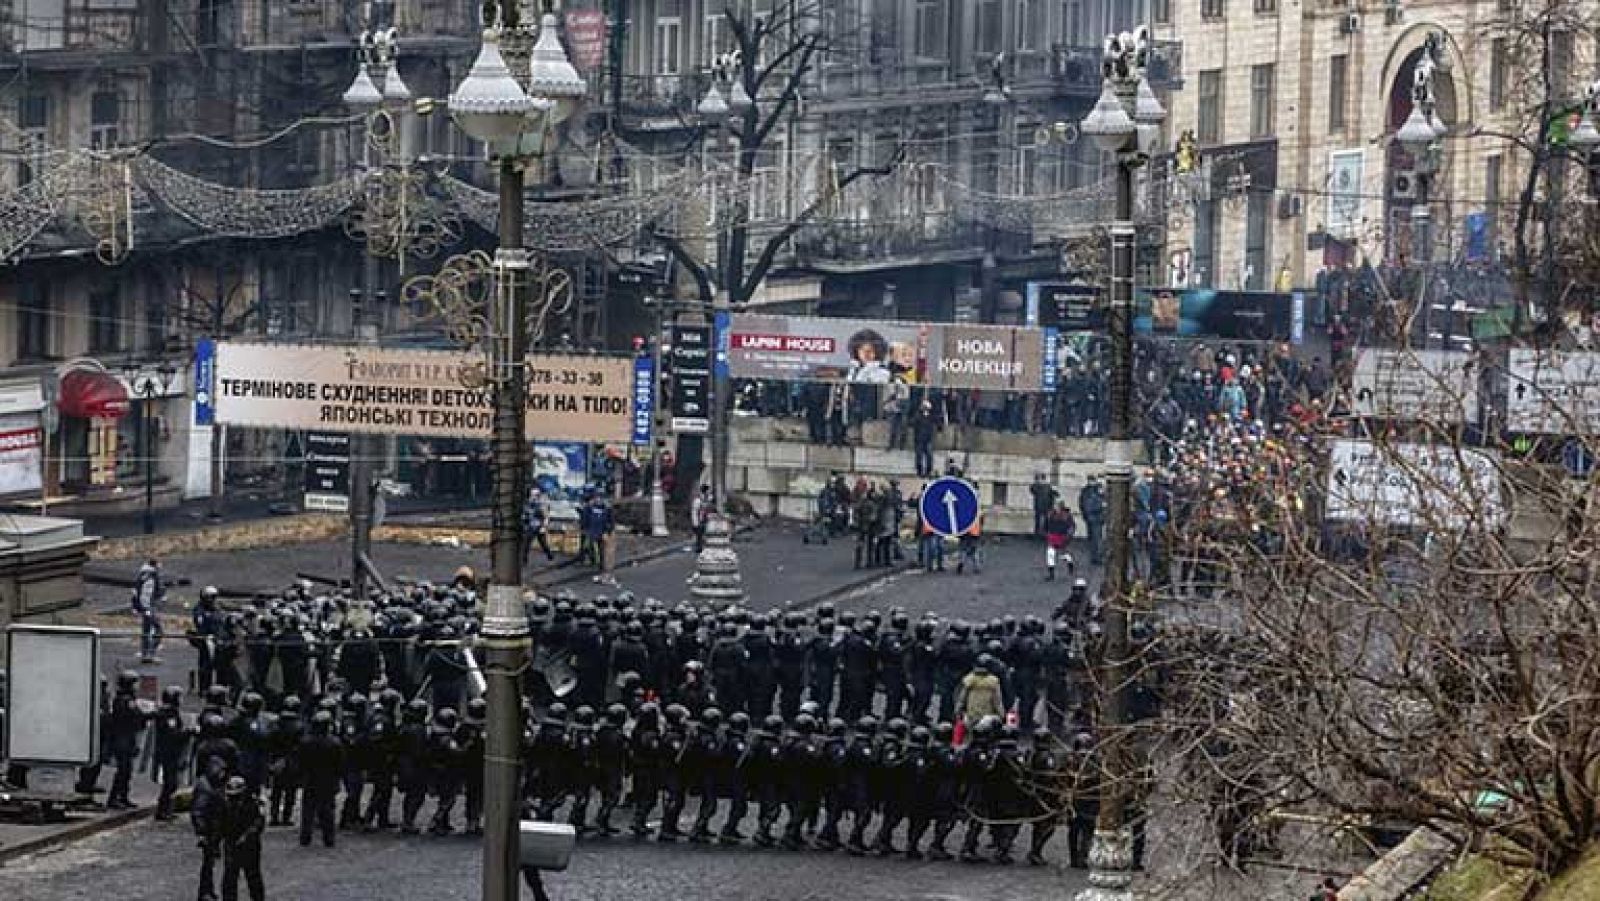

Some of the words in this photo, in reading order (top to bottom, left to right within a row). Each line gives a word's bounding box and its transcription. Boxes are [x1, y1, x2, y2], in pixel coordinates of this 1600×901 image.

[741, 335, 780, 350] LAPIN
[787, 338, 831, 352] HOUSE
[957, 339, 1005, 356] НОВА
[937, 358, 1024, 376] КОЛЕКЦІЯ
[221, 379, 316, 399] ТЕРМІНОВЕ
[321, 383, 428, 405] СХУДНЕННЯ!
[553, 394, 578, 413] НА
[582, 396, 627, 416] ТІЛО!
[320, 404, 412, 426] ЯПОНСЬКІ
[418, 410, 491, 430] ТЕХНОЛ
